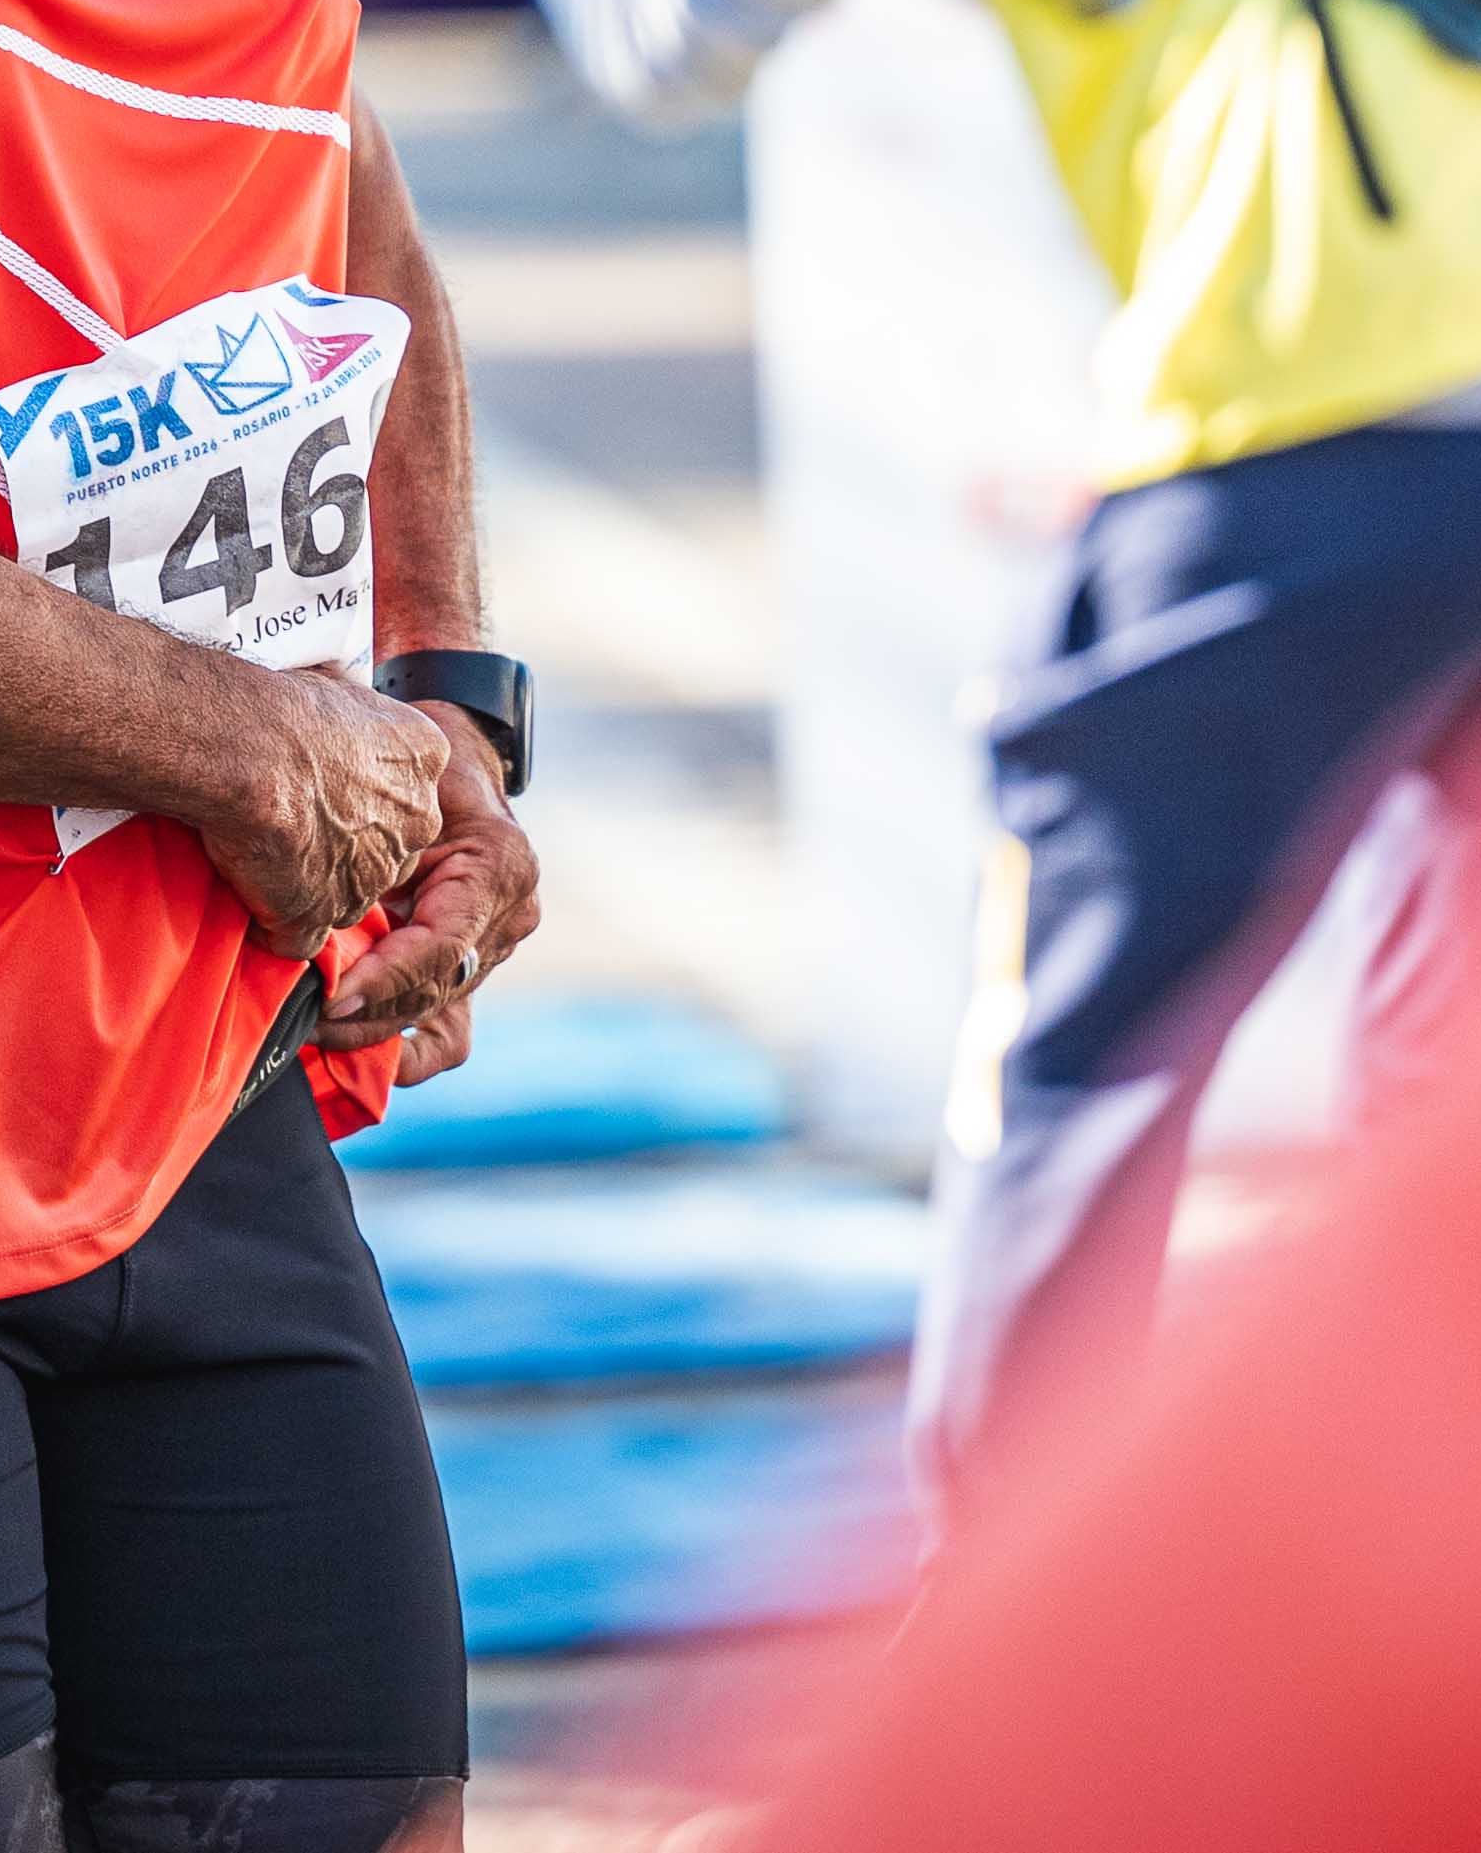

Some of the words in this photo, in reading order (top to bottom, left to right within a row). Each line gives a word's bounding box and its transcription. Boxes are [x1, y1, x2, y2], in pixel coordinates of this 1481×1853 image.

[49, 370, 193, 479] 15K
[67, 474, 126, 505] PUERTO
[131, 454, 179, 482] NORTE
[184, 438, 218, 462] 2026
[233, 406, 291, 440] ROSARIO
[304, 392, 319, 408] 12
[334, 364, 361, 389] ABRIL
[253, 605, 306, 644] Jose
